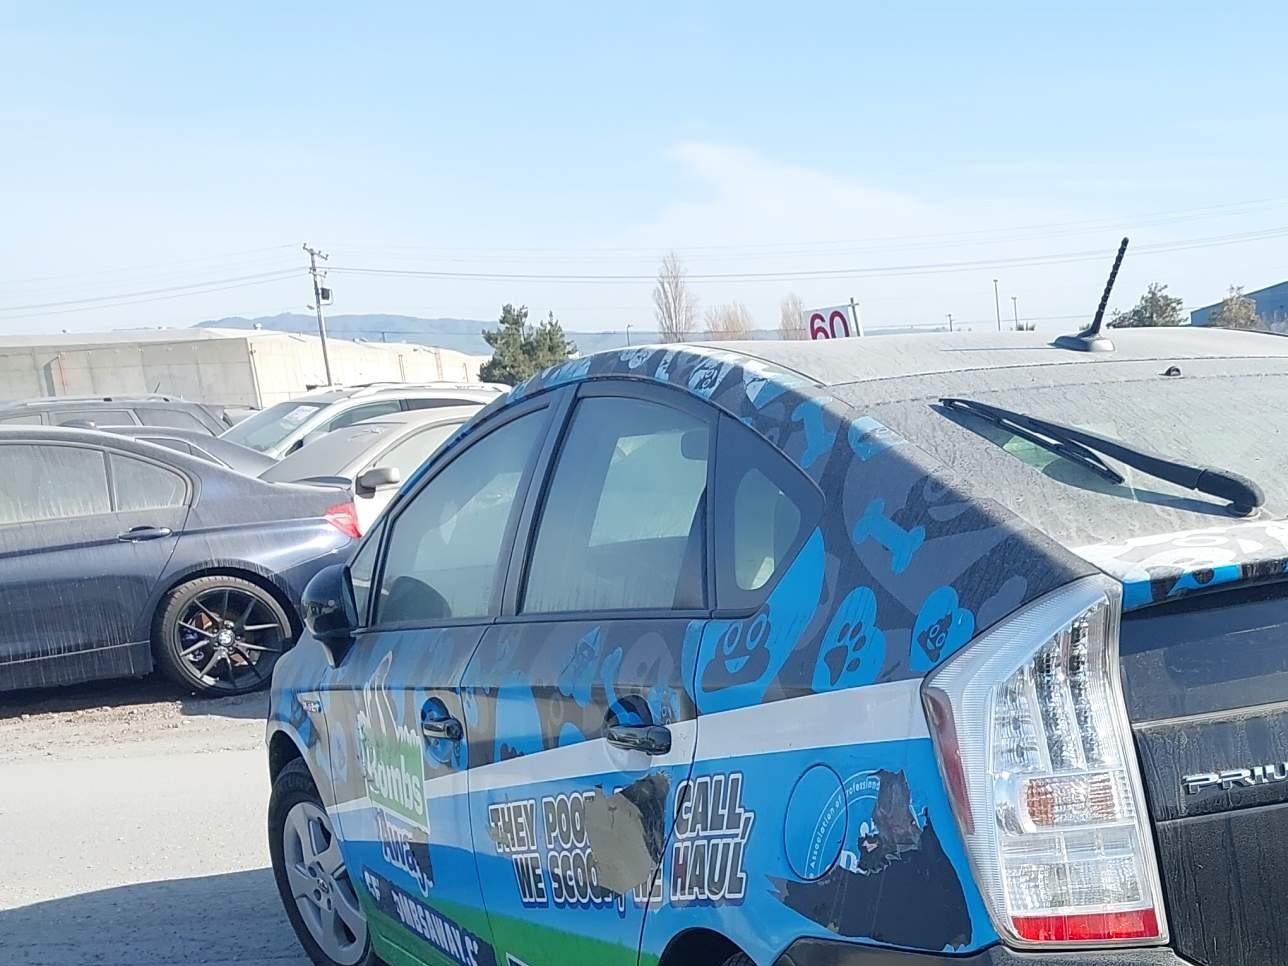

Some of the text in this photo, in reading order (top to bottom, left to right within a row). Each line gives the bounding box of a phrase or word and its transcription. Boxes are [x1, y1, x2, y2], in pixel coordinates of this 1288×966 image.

[809, 309, 850, 340] 60
[488, 799, 539, 852] THEY
[673, 773, 756, 842] CALL,
[511, 853, 549, 902] WE
[671, 838, 747, 900] HAUL
